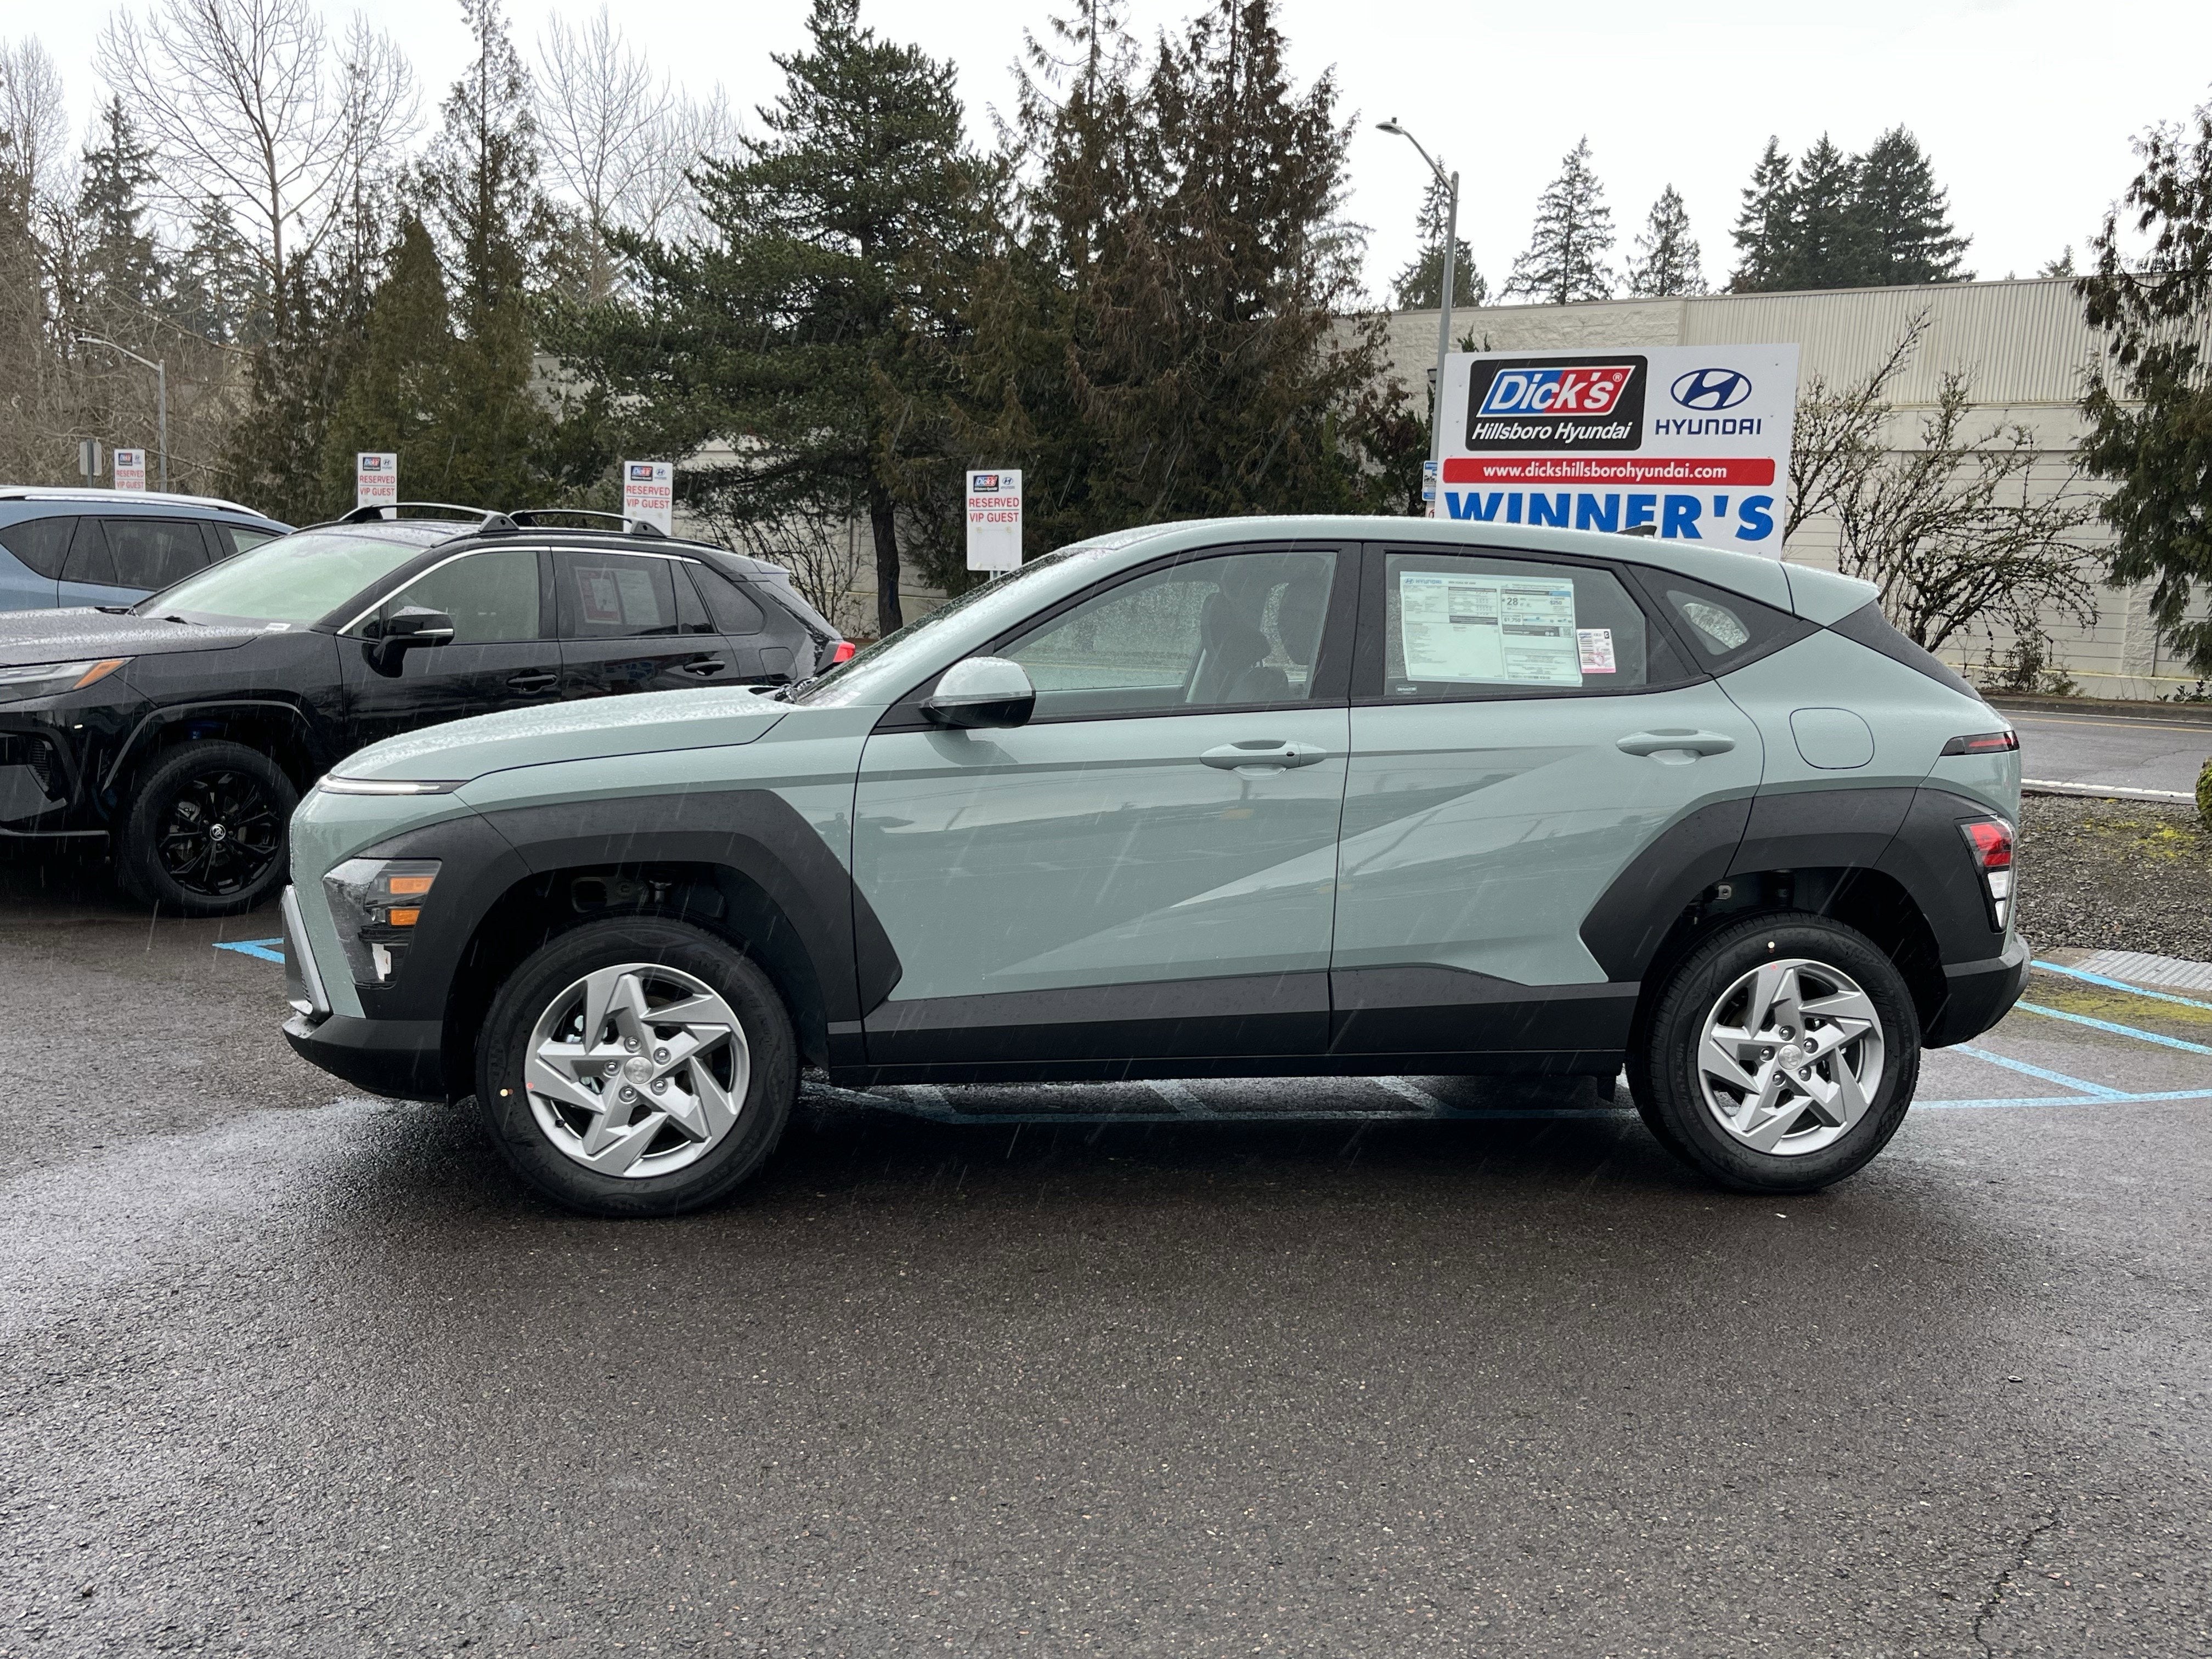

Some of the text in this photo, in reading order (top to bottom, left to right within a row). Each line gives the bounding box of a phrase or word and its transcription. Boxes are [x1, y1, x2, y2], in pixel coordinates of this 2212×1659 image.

[1489, 371, 1614, 410] Dick's
[1655, 418, 1761, 436] HYUNDAI
[1472, 422, 1633, 443] Hillsboro Hyundai
[116, 469, 144, 477] RESERVED
[1483, 462, 1727, 482] www.dickshillsborohyundai.com
[359, 475, 395, 483] RESERVED
[360, 487, 395, 496] VIP GUEST
[626, 486, 670, 496] RESERVED
[627, 499, 670, 509] VIP GUEST
[969, 498, 1019, 507] RESERVED
[969, 512, 1019, 522] VIP GUEST
[1444, 492, 1774, 541] WINNER'S
